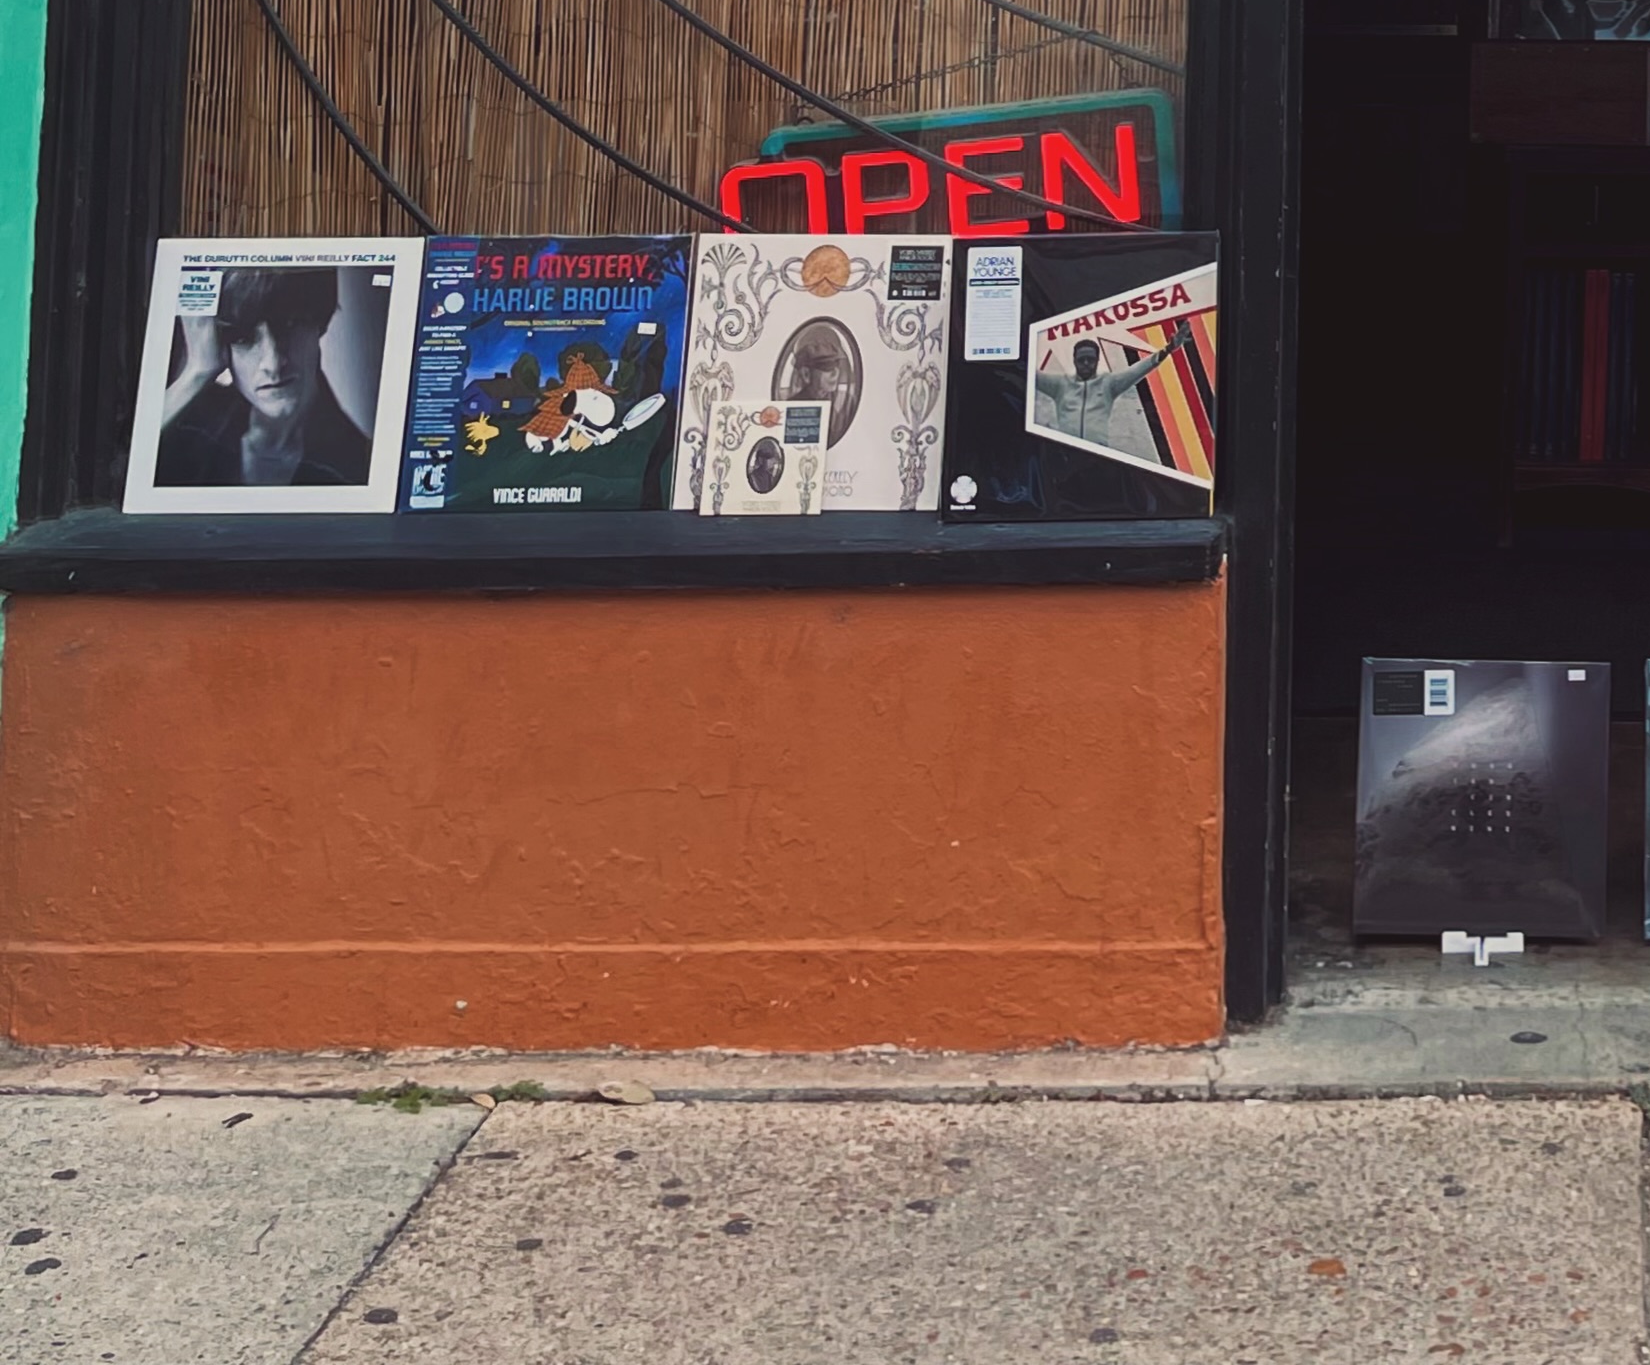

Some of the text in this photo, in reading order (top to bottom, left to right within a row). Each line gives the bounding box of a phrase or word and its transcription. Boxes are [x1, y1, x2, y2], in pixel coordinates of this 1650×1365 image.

[719, 122, 1142, 239] OPEN
[183, 254, 202, 263] THE
[204, 254, 249, 263] DURUTTI
[250, 254, 293, 263] COLUMN
[351, 254, 376, 263] FACT
[512, 255, 529, 279] A
[537, 254, 654, 281] MYSTERY,
[976, 256, 1015, 266] ADRIAN
[972, 267, 1017, 277] YOUNGE
[472, 286, 652, 313] HARLIE BROWN
[493, 486, 582, 504] VINCE GUARALDI
